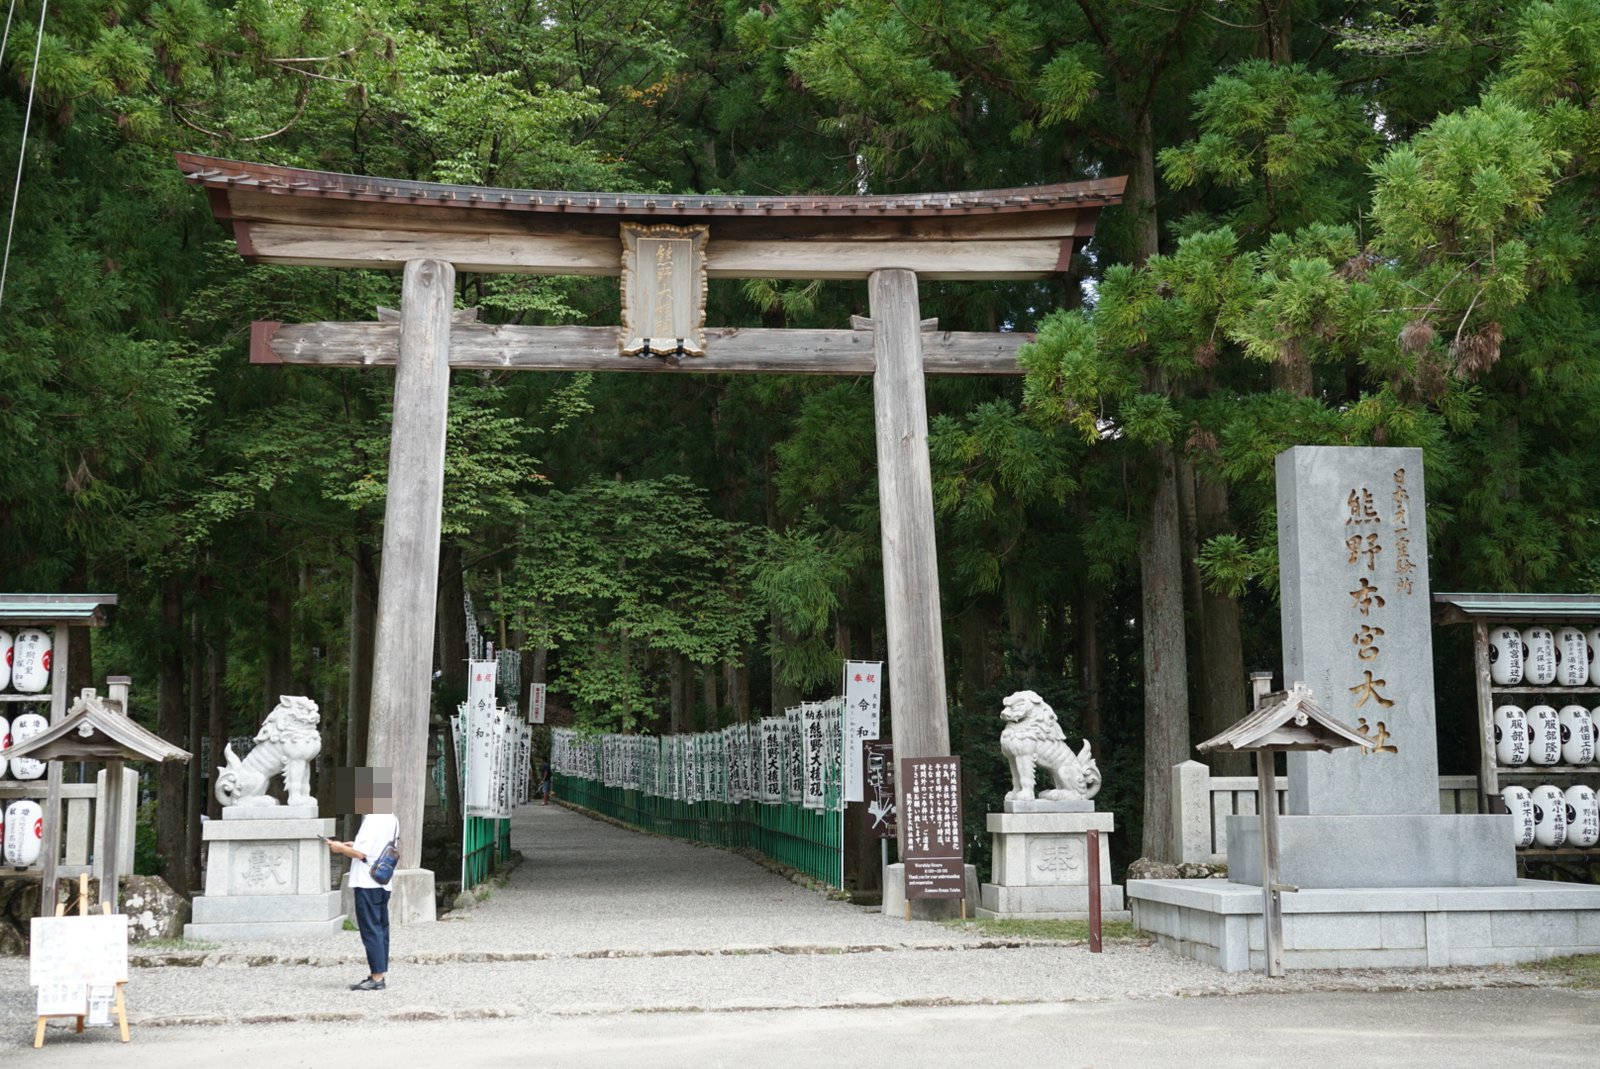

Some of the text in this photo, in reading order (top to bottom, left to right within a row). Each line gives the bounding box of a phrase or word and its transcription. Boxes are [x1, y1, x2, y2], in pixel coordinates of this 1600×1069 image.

[1345, 488, 1398, 756] 熊野本宮大社
[854, 673, 876, 683] 奉祝
[475, 699, 486, 739] 令和
[764, 724, 780, 733] 奉納
[805, 709, 824, 720] 奉納
[856, 698, 871, 738] 令和
[809, 721, 823, 797] 熊野大権現
[1544, 720, 1557, 763] 服部隆弘
[767, 734, 781, 795] 熊野大権現
